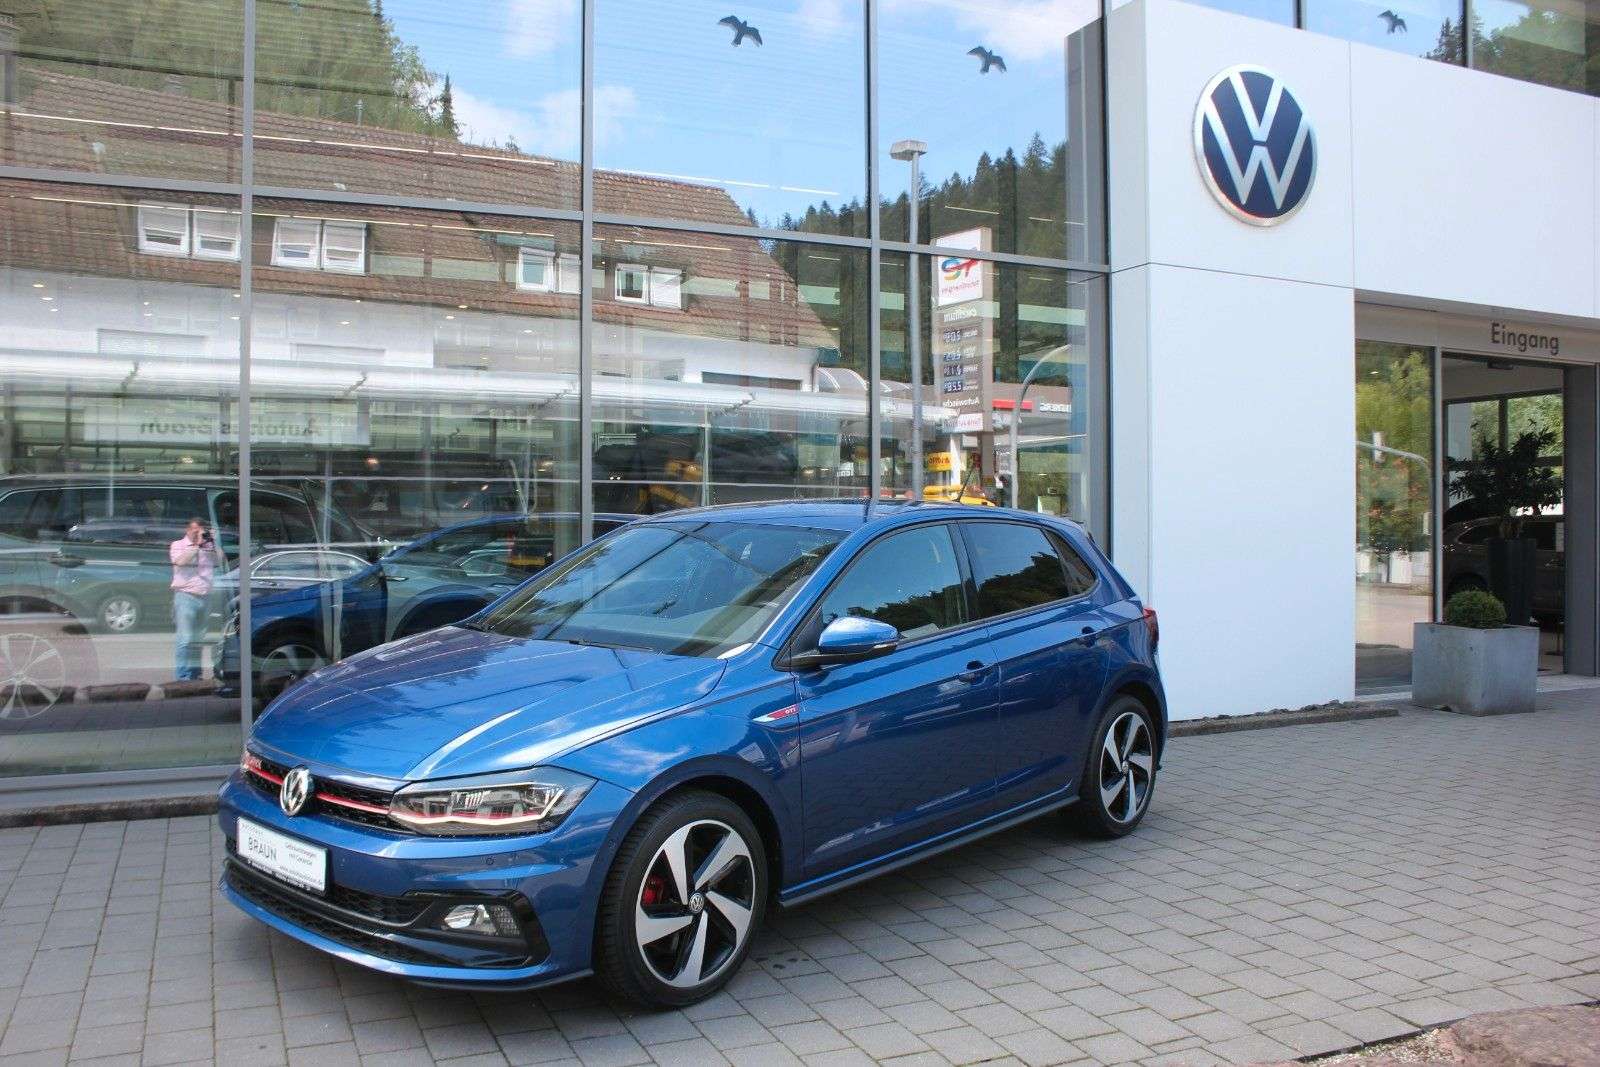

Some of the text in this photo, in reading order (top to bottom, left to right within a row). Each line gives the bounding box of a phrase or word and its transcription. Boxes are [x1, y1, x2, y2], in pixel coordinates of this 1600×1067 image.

[1198, 67, 1313, 212] VW
[1491, 321, 1559, 355] Eingang
[248, 836, 278, 861] BRAUN
